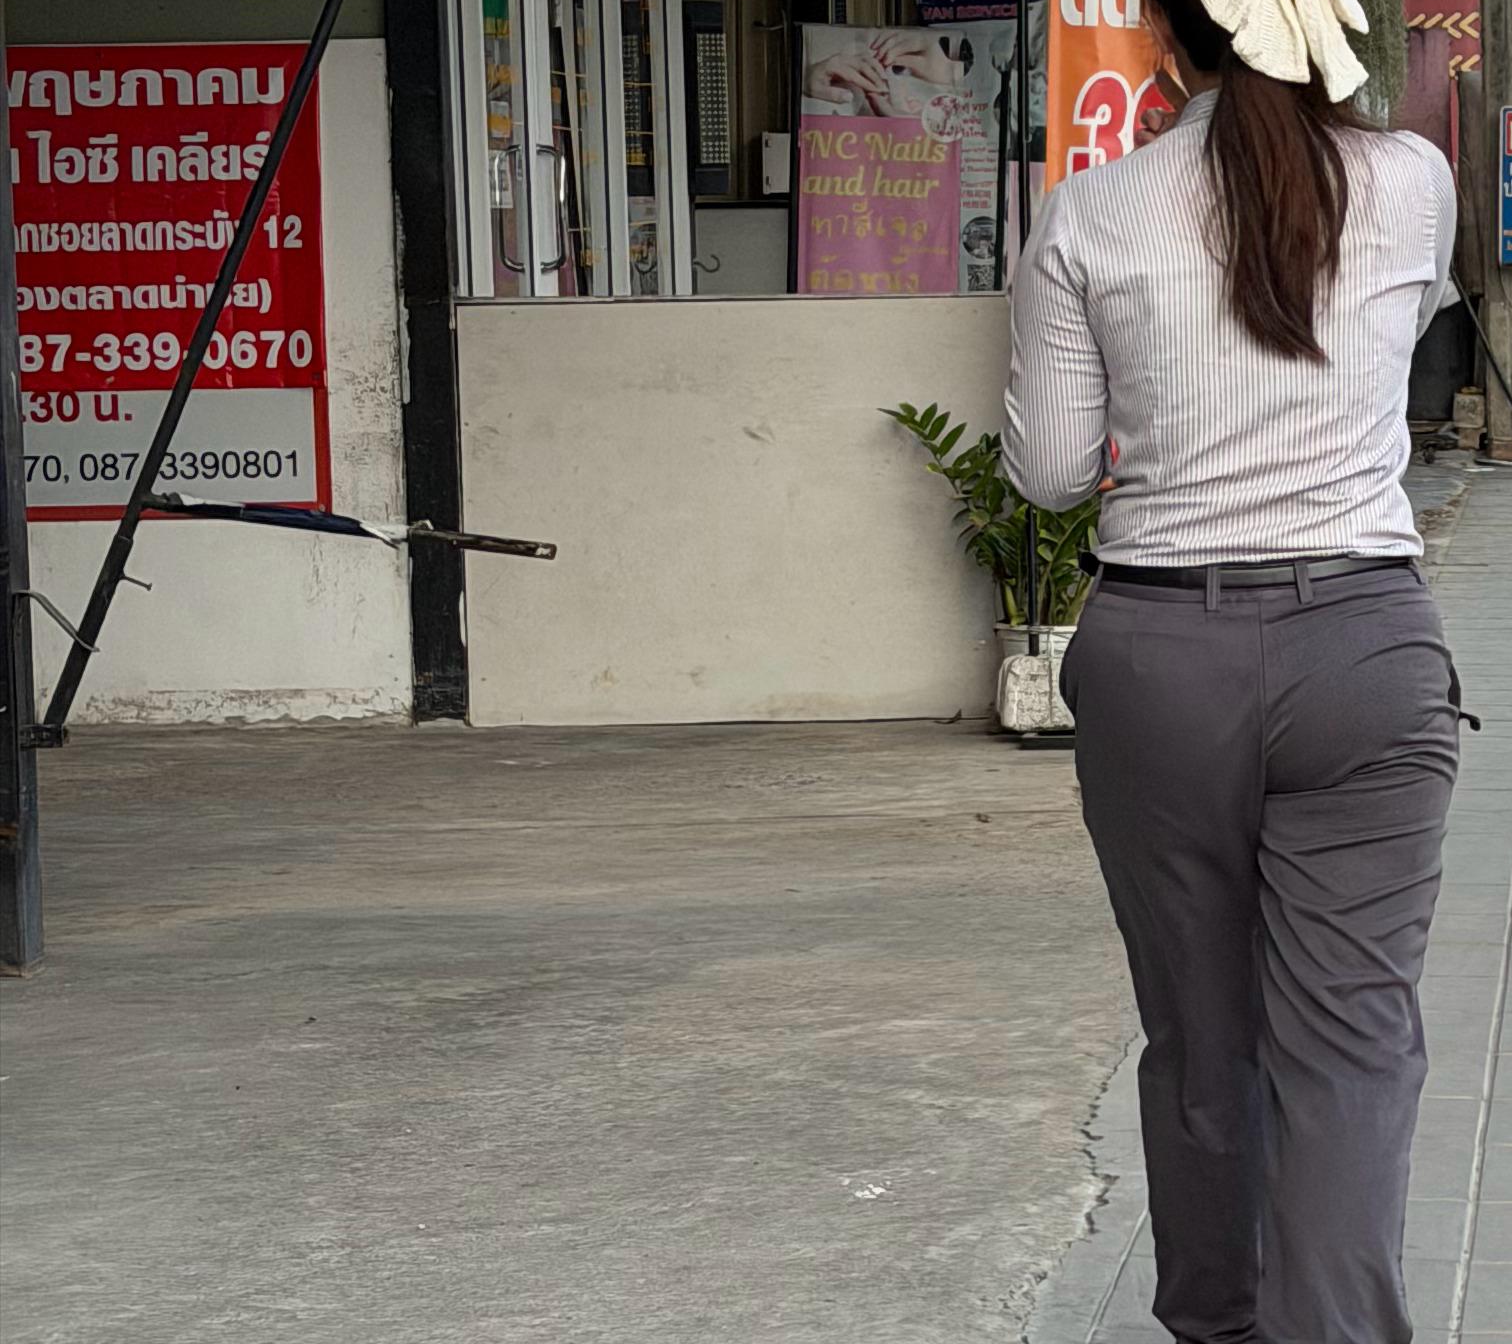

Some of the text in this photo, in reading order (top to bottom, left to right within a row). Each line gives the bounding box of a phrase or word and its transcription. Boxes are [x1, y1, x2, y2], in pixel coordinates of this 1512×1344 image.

[26, 130, 119, 184] ไอซี
[131, 130, 272, 182] เคลียร์
[804, 129, 949, 163] NC Nails
[803, 165, 866, 196] and
[872, 165, 940, 199] hair
[263, 214, 303, 249] 12
[79, 450, 298, 484] 0873390801
